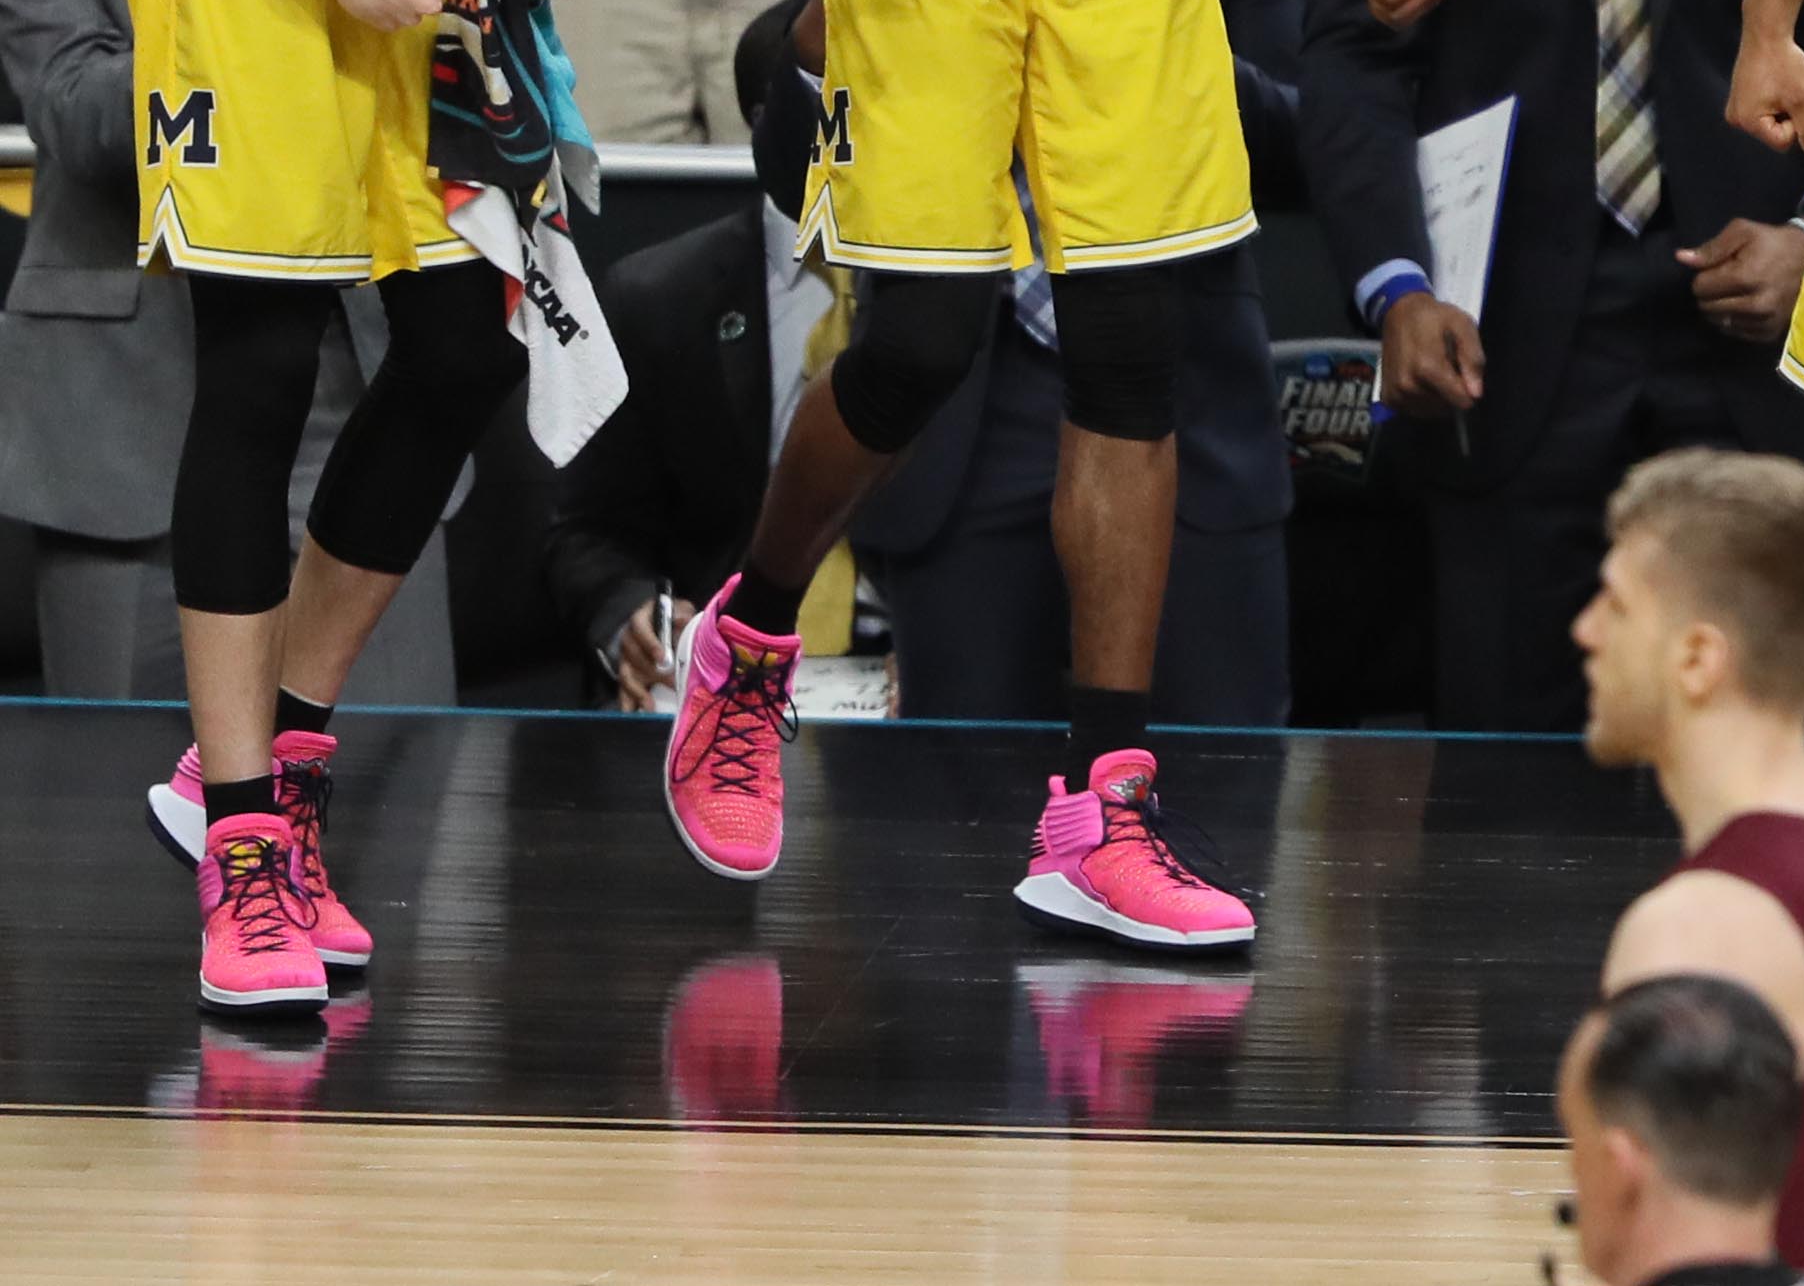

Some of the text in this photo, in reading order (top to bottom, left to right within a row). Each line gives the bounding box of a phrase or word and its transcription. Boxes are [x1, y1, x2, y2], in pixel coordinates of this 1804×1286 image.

[147, 88, 217, 166] M
[811, 88, 853, 166] M
[1280, 376, 1372, 410] FINAL
[1286, 408, 1372, 436] FOUR
